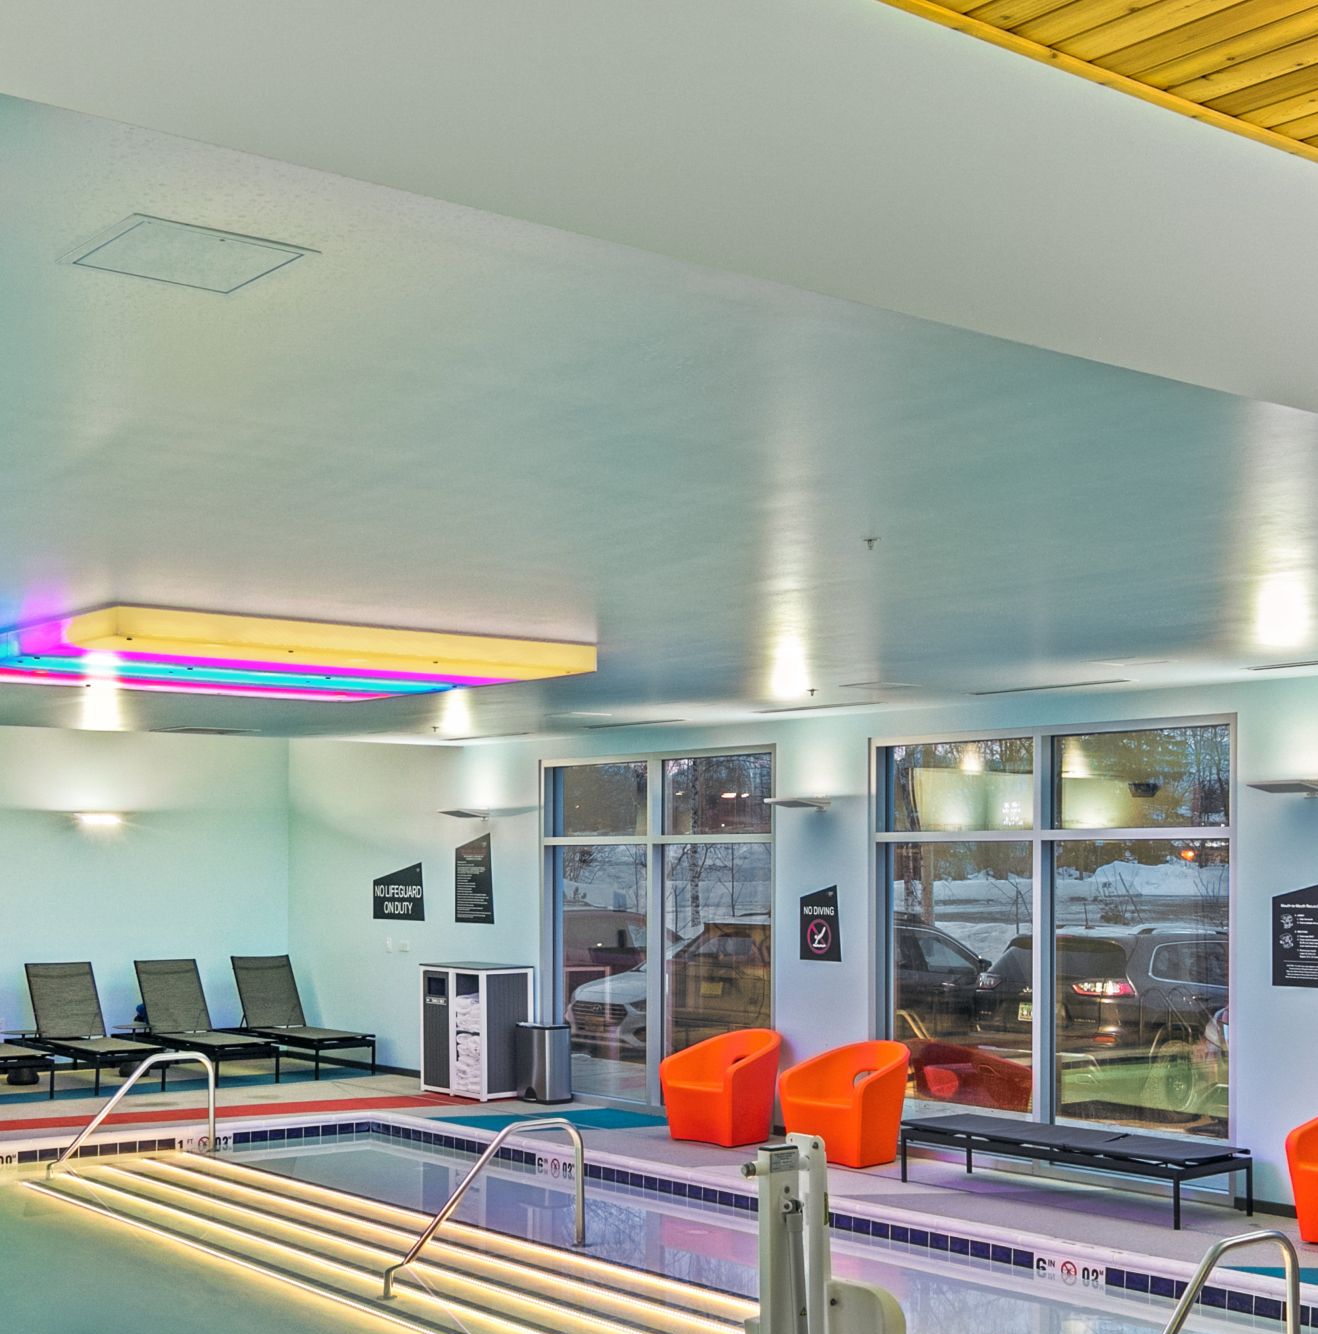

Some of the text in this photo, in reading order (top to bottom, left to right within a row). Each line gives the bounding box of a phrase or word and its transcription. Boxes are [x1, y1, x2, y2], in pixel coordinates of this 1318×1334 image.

[374, 884, 422, 898] NO LIFEGUARD
[384, 901, 414, 914] ON DUTY
[803, 906, 835, 916] NO DIVING
